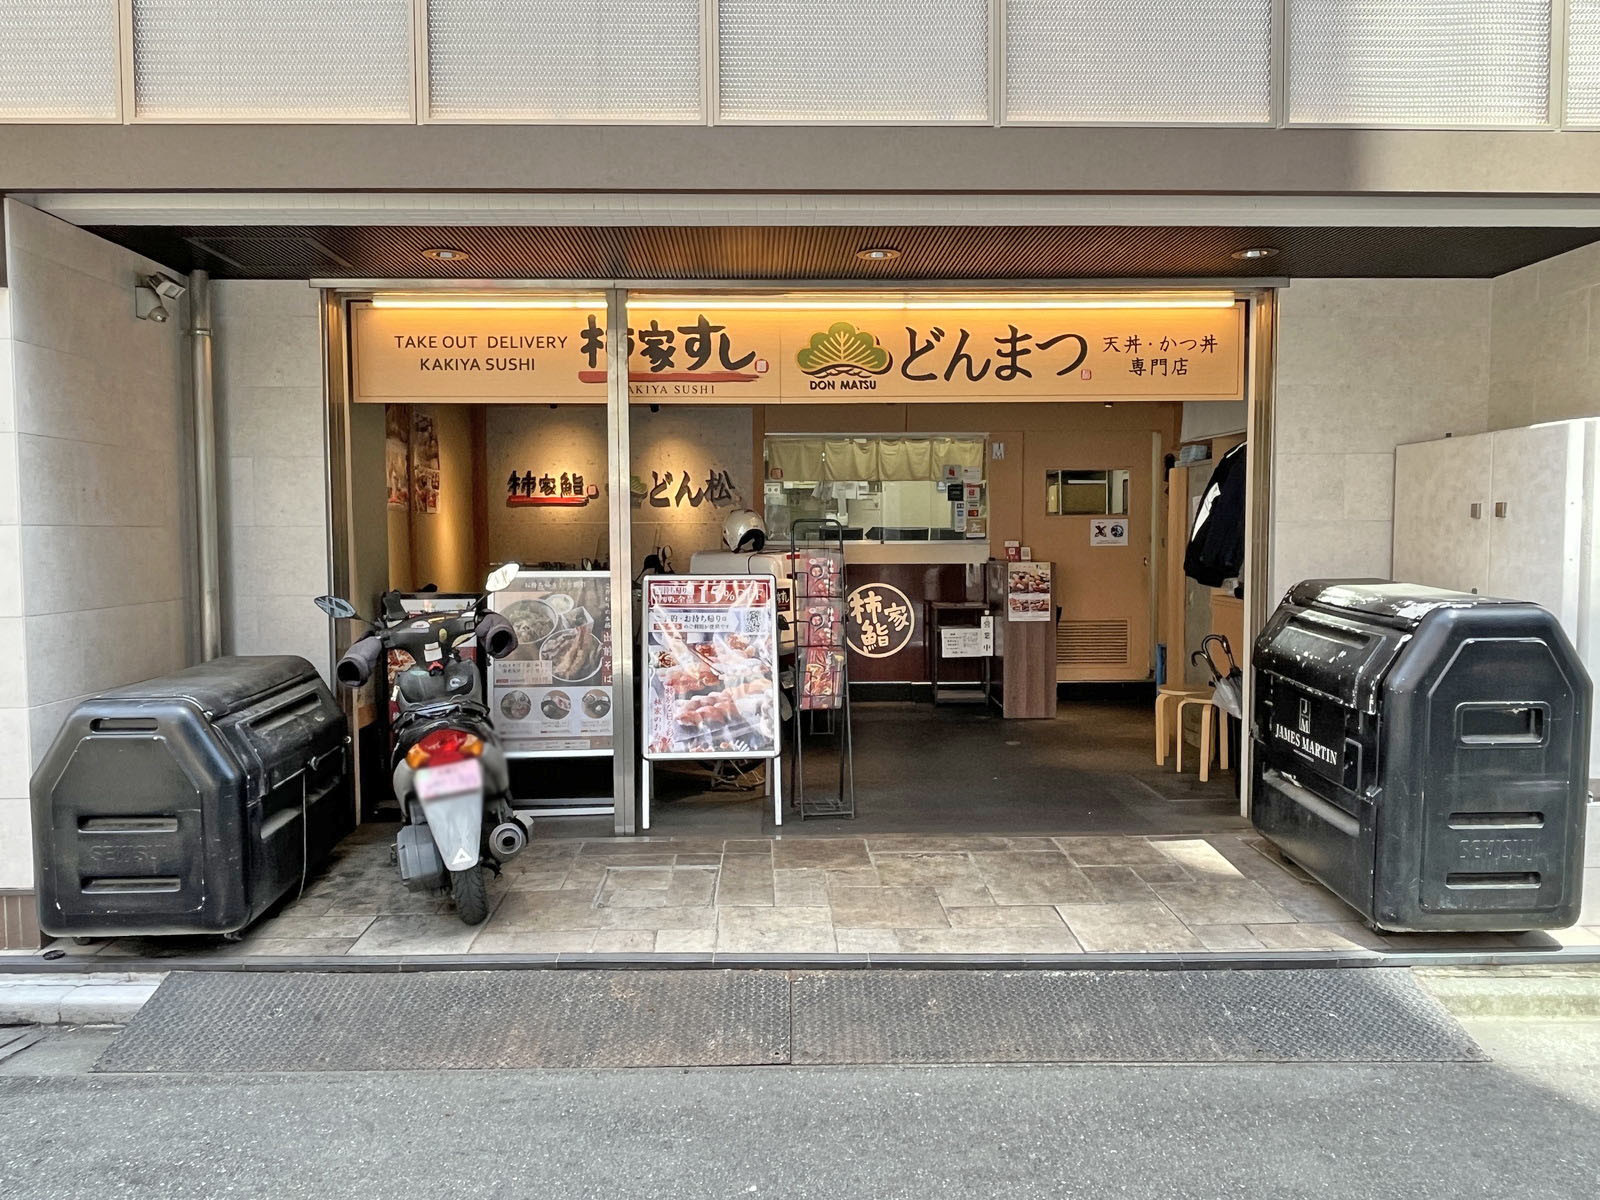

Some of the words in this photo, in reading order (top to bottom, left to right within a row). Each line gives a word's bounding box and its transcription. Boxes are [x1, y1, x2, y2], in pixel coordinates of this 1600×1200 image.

[394, 335, 437, 349] TAKE
[443, 335, 478, 349] OUT
[487, 335, 568, 349] DELIVERY
[1103, 335, 1218, 353] 天丼・かつ丼
[901, 324, 1088, 382] どんまつ
[420, 358, 480, 371] KAKIYA
[485, 358, 535, 371] SUSHI
[1129, 357, 1188, 376] 専門店
[628, 385, 668, 395] AKIYA
[674, 384, 714, 395] SUSHI
[809, 380, 836, 390] DON
[840, 380, 876, 390] MATSU
[649, 469, 735, 506] どん松
[849, 590, 910, 654] 柿家鮨
[1275, 723, 1301, 747] JAMES
[1301, 736, 1338, 766] MARTIN
